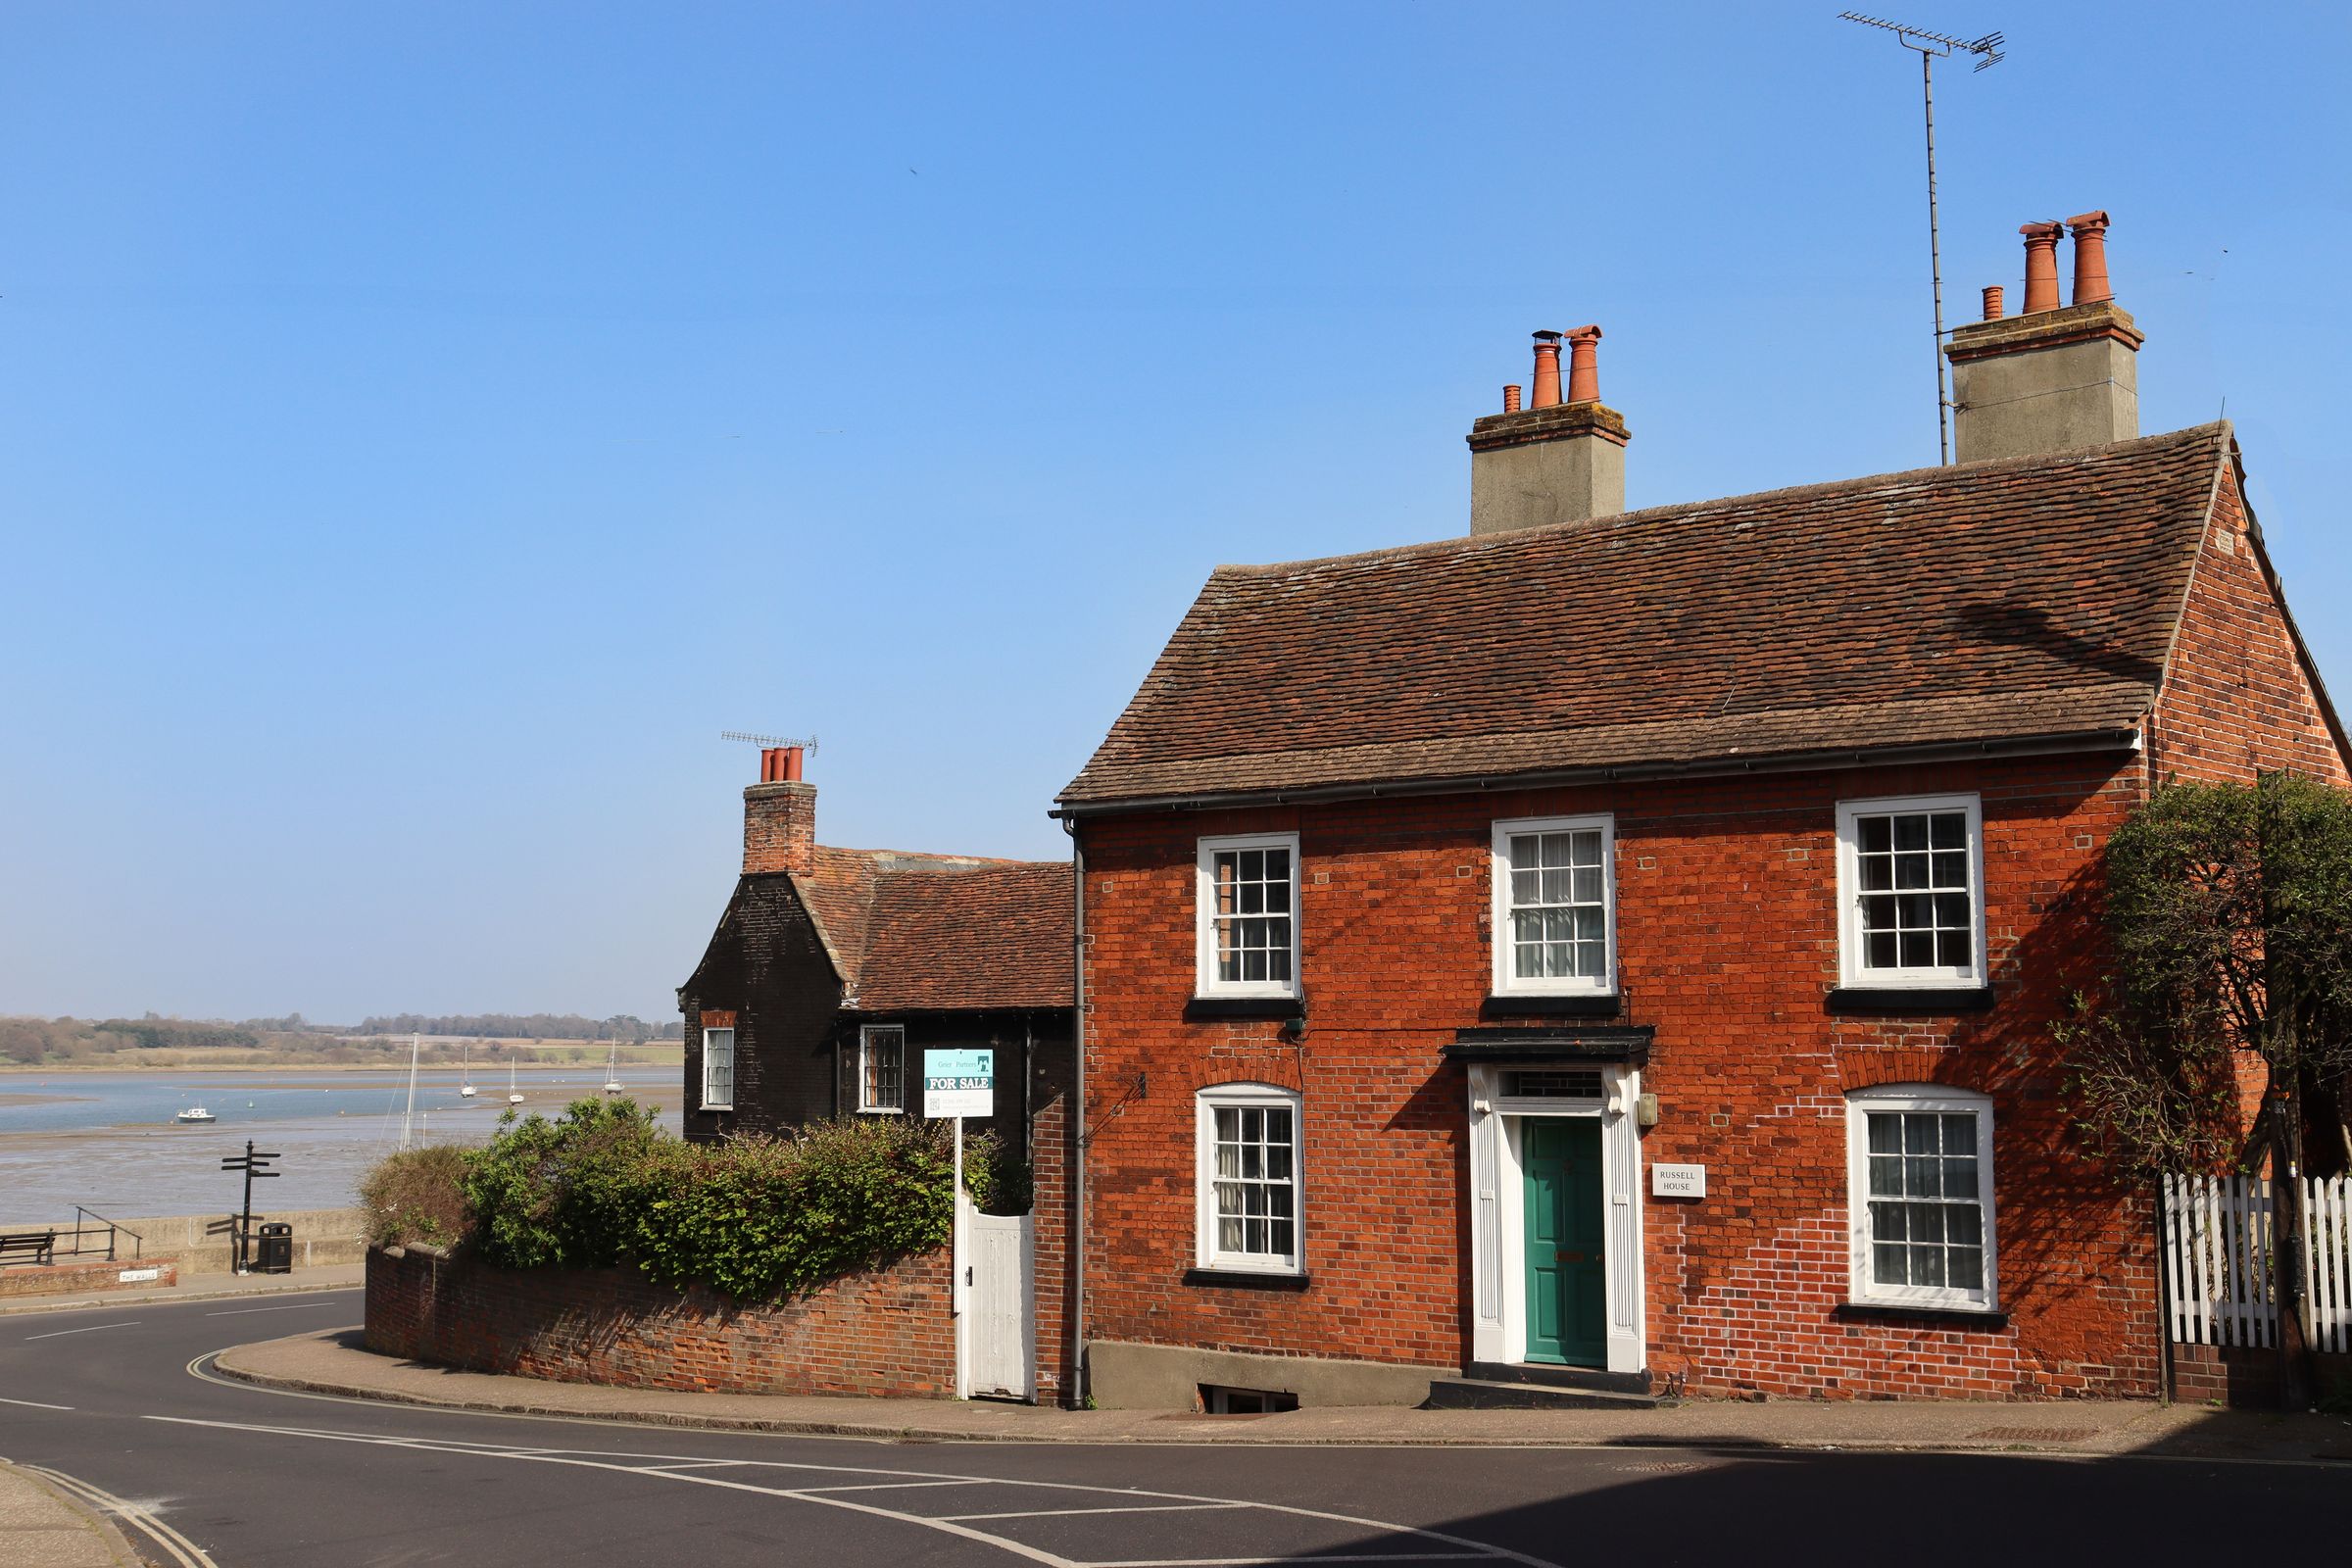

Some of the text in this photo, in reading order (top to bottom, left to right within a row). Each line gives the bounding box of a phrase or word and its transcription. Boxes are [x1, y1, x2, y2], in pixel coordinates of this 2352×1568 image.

[929, 1078, 989, 1090] FOR SALE
[1660, 1171, 1695, 1180] RUSSELL
[1663, 1182, 1690, 1191] HOUSE
